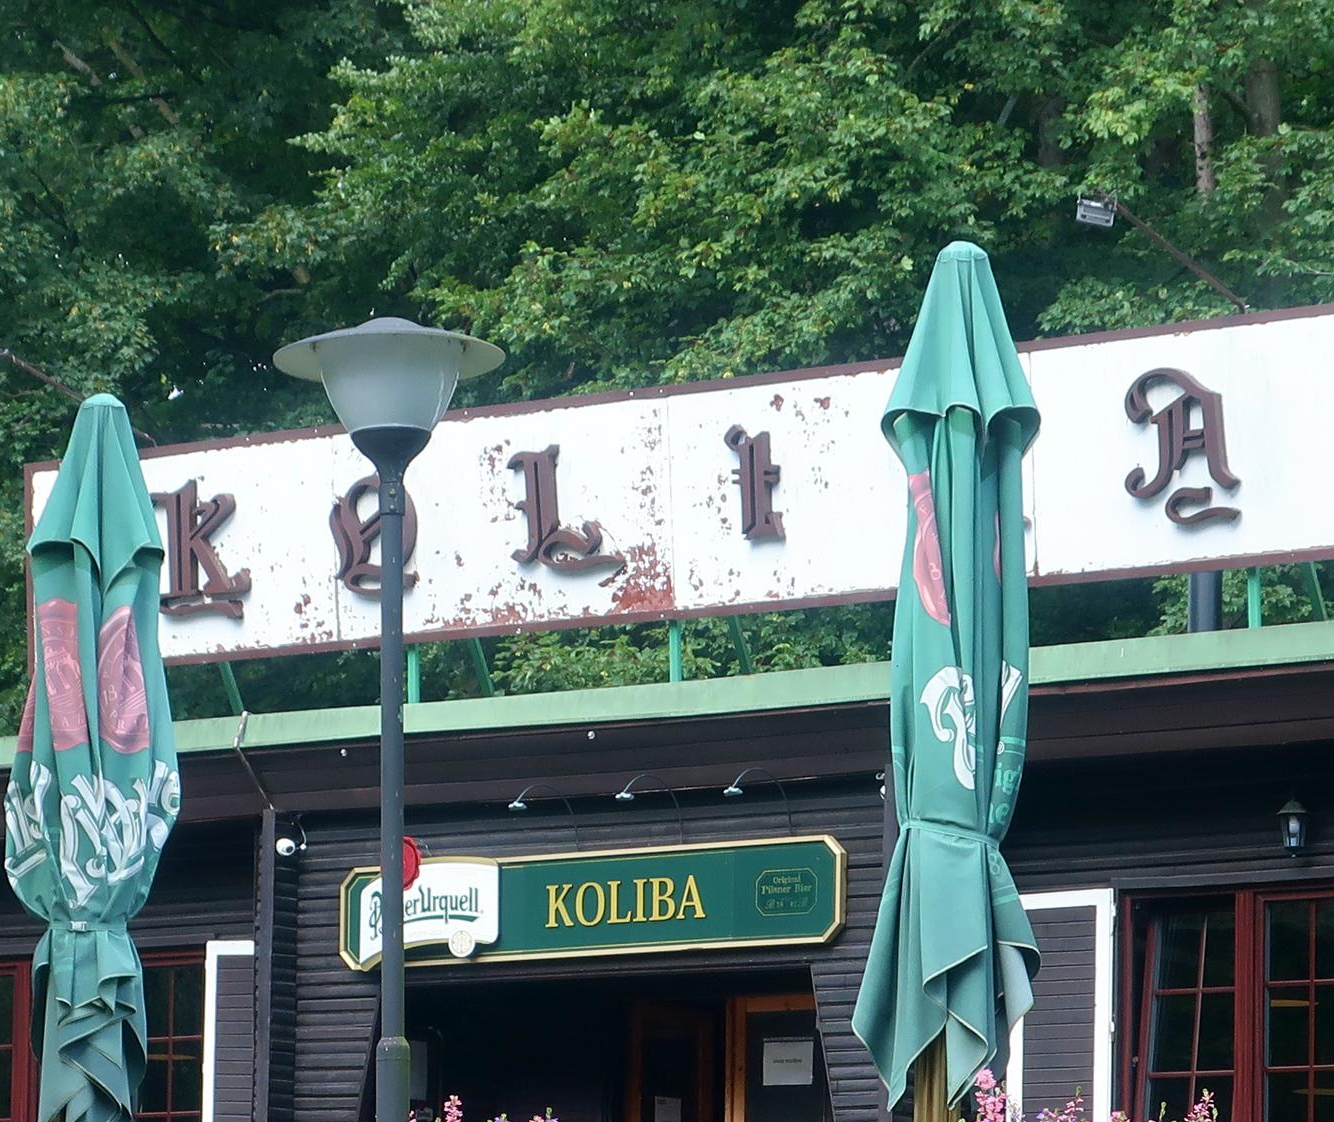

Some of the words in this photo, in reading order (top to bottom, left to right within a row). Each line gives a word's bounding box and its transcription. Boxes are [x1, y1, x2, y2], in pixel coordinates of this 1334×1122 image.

[153, 366, 1242, 620] KOLIA
[418, 885, 479, 924] Urquell
[544, 874, 707, 928] KOLIBA
